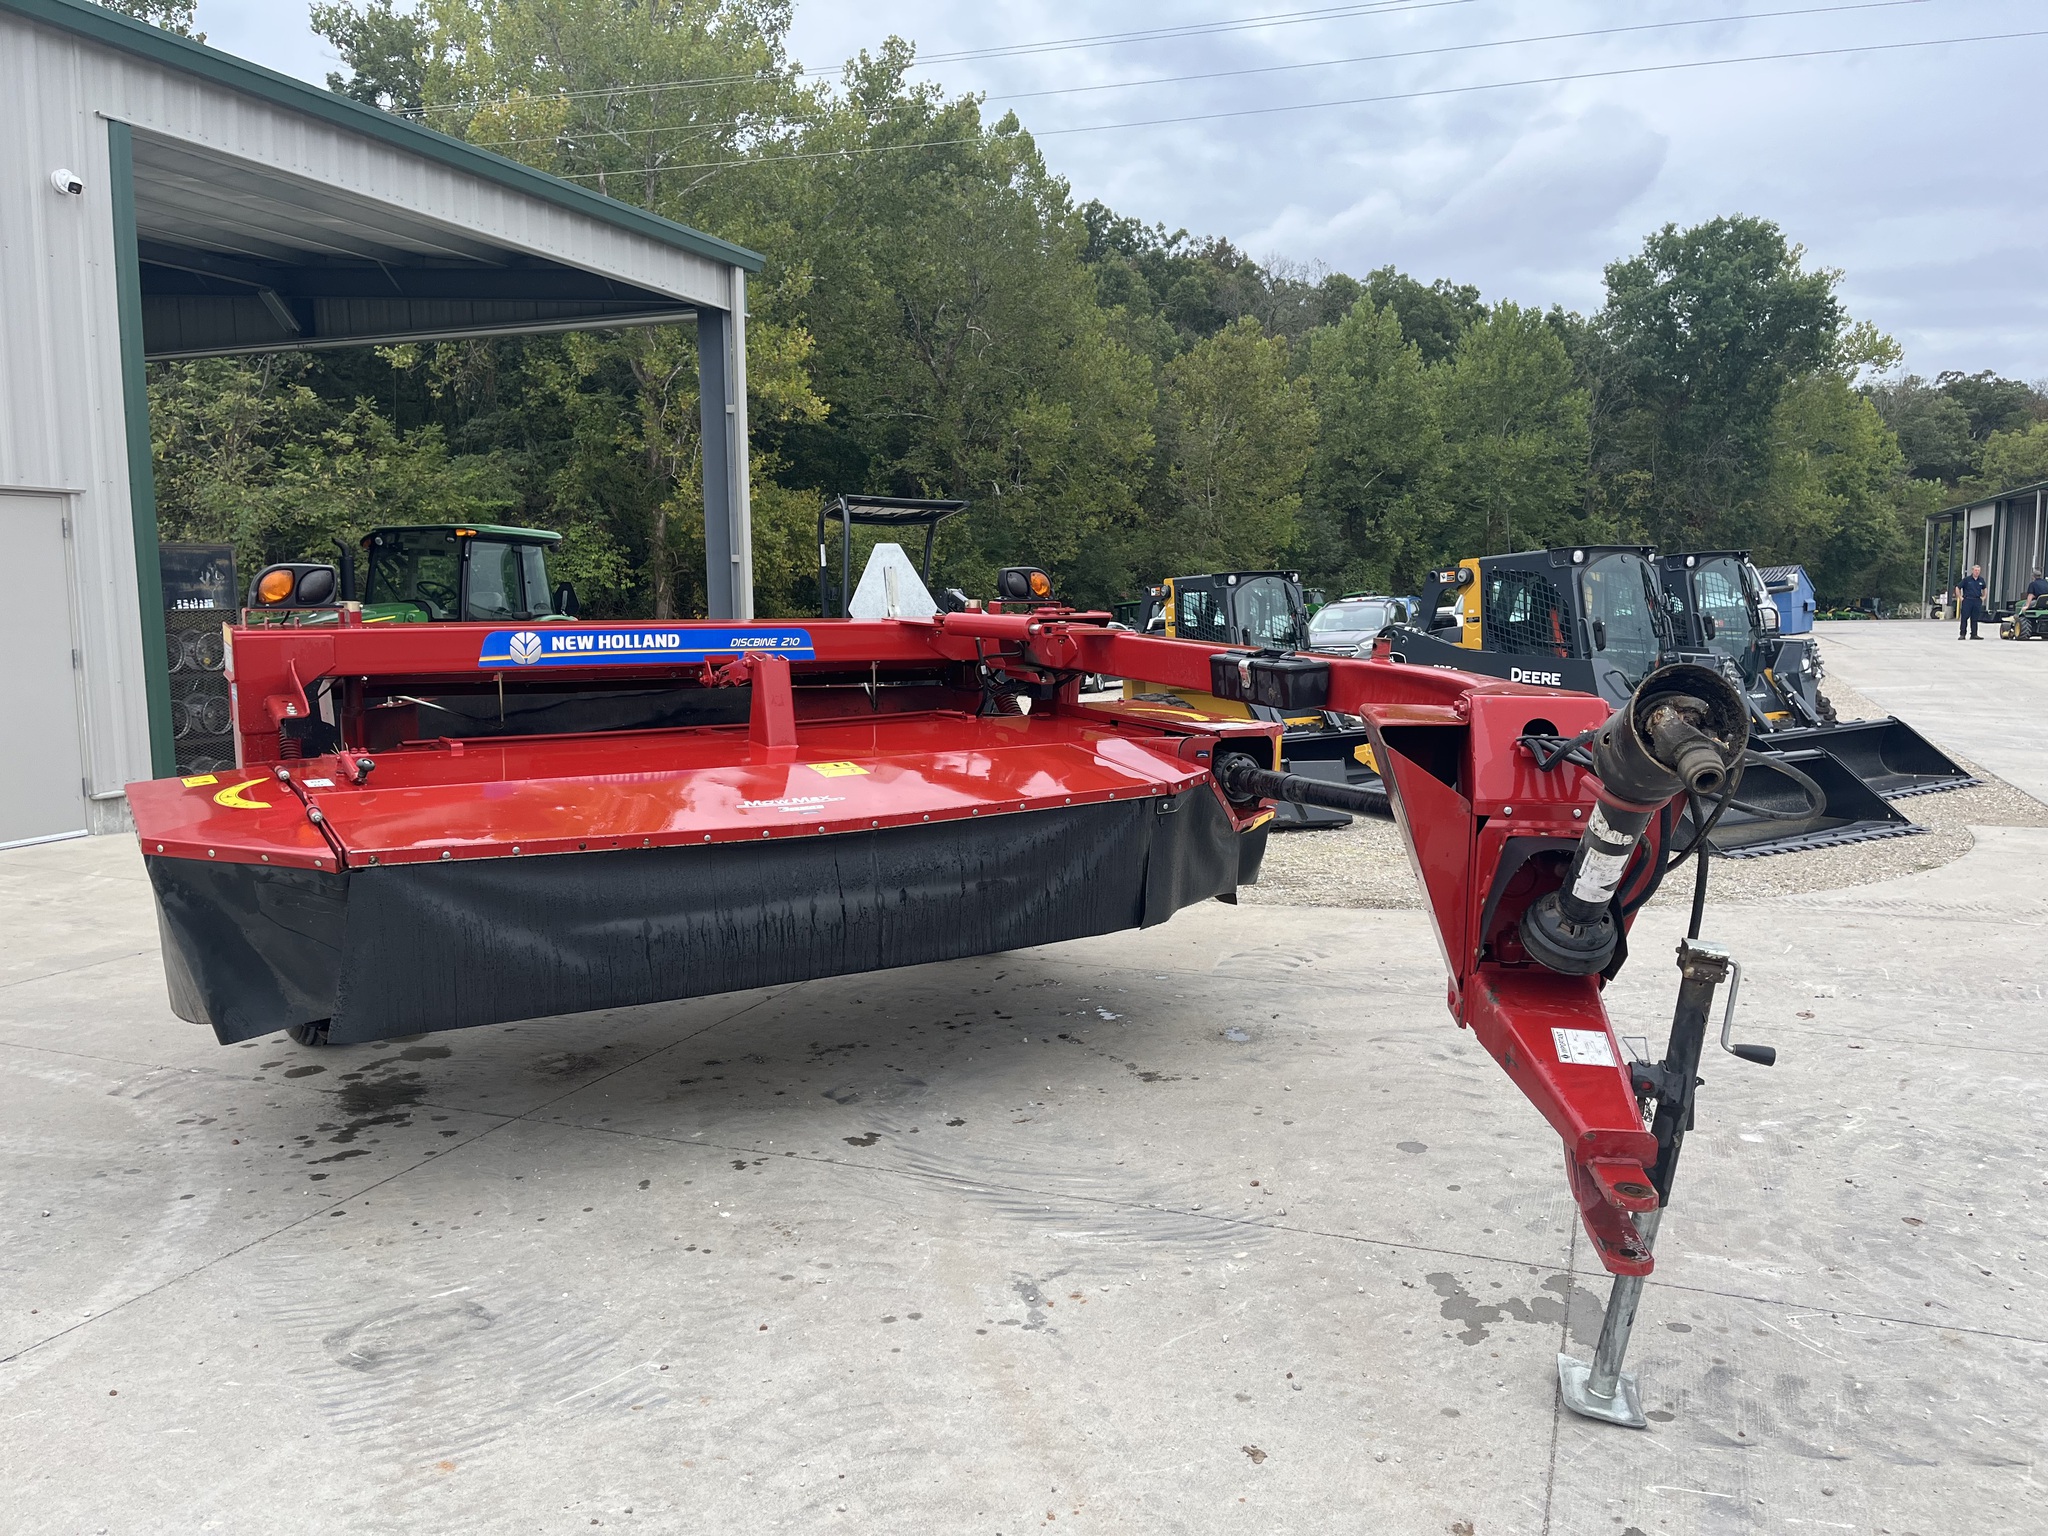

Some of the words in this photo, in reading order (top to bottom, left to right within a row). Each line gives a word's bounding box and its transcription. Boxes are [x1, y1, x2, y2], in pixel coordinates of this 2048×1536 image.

[551, 635, 595, 651] NEW
[598, 633, 680, 650] HOLLAND
[730, 637, 777, 648] DISCBINE
[781, 637, 800, 647] 210
[1510, 667, 1562, 686] DEERE
